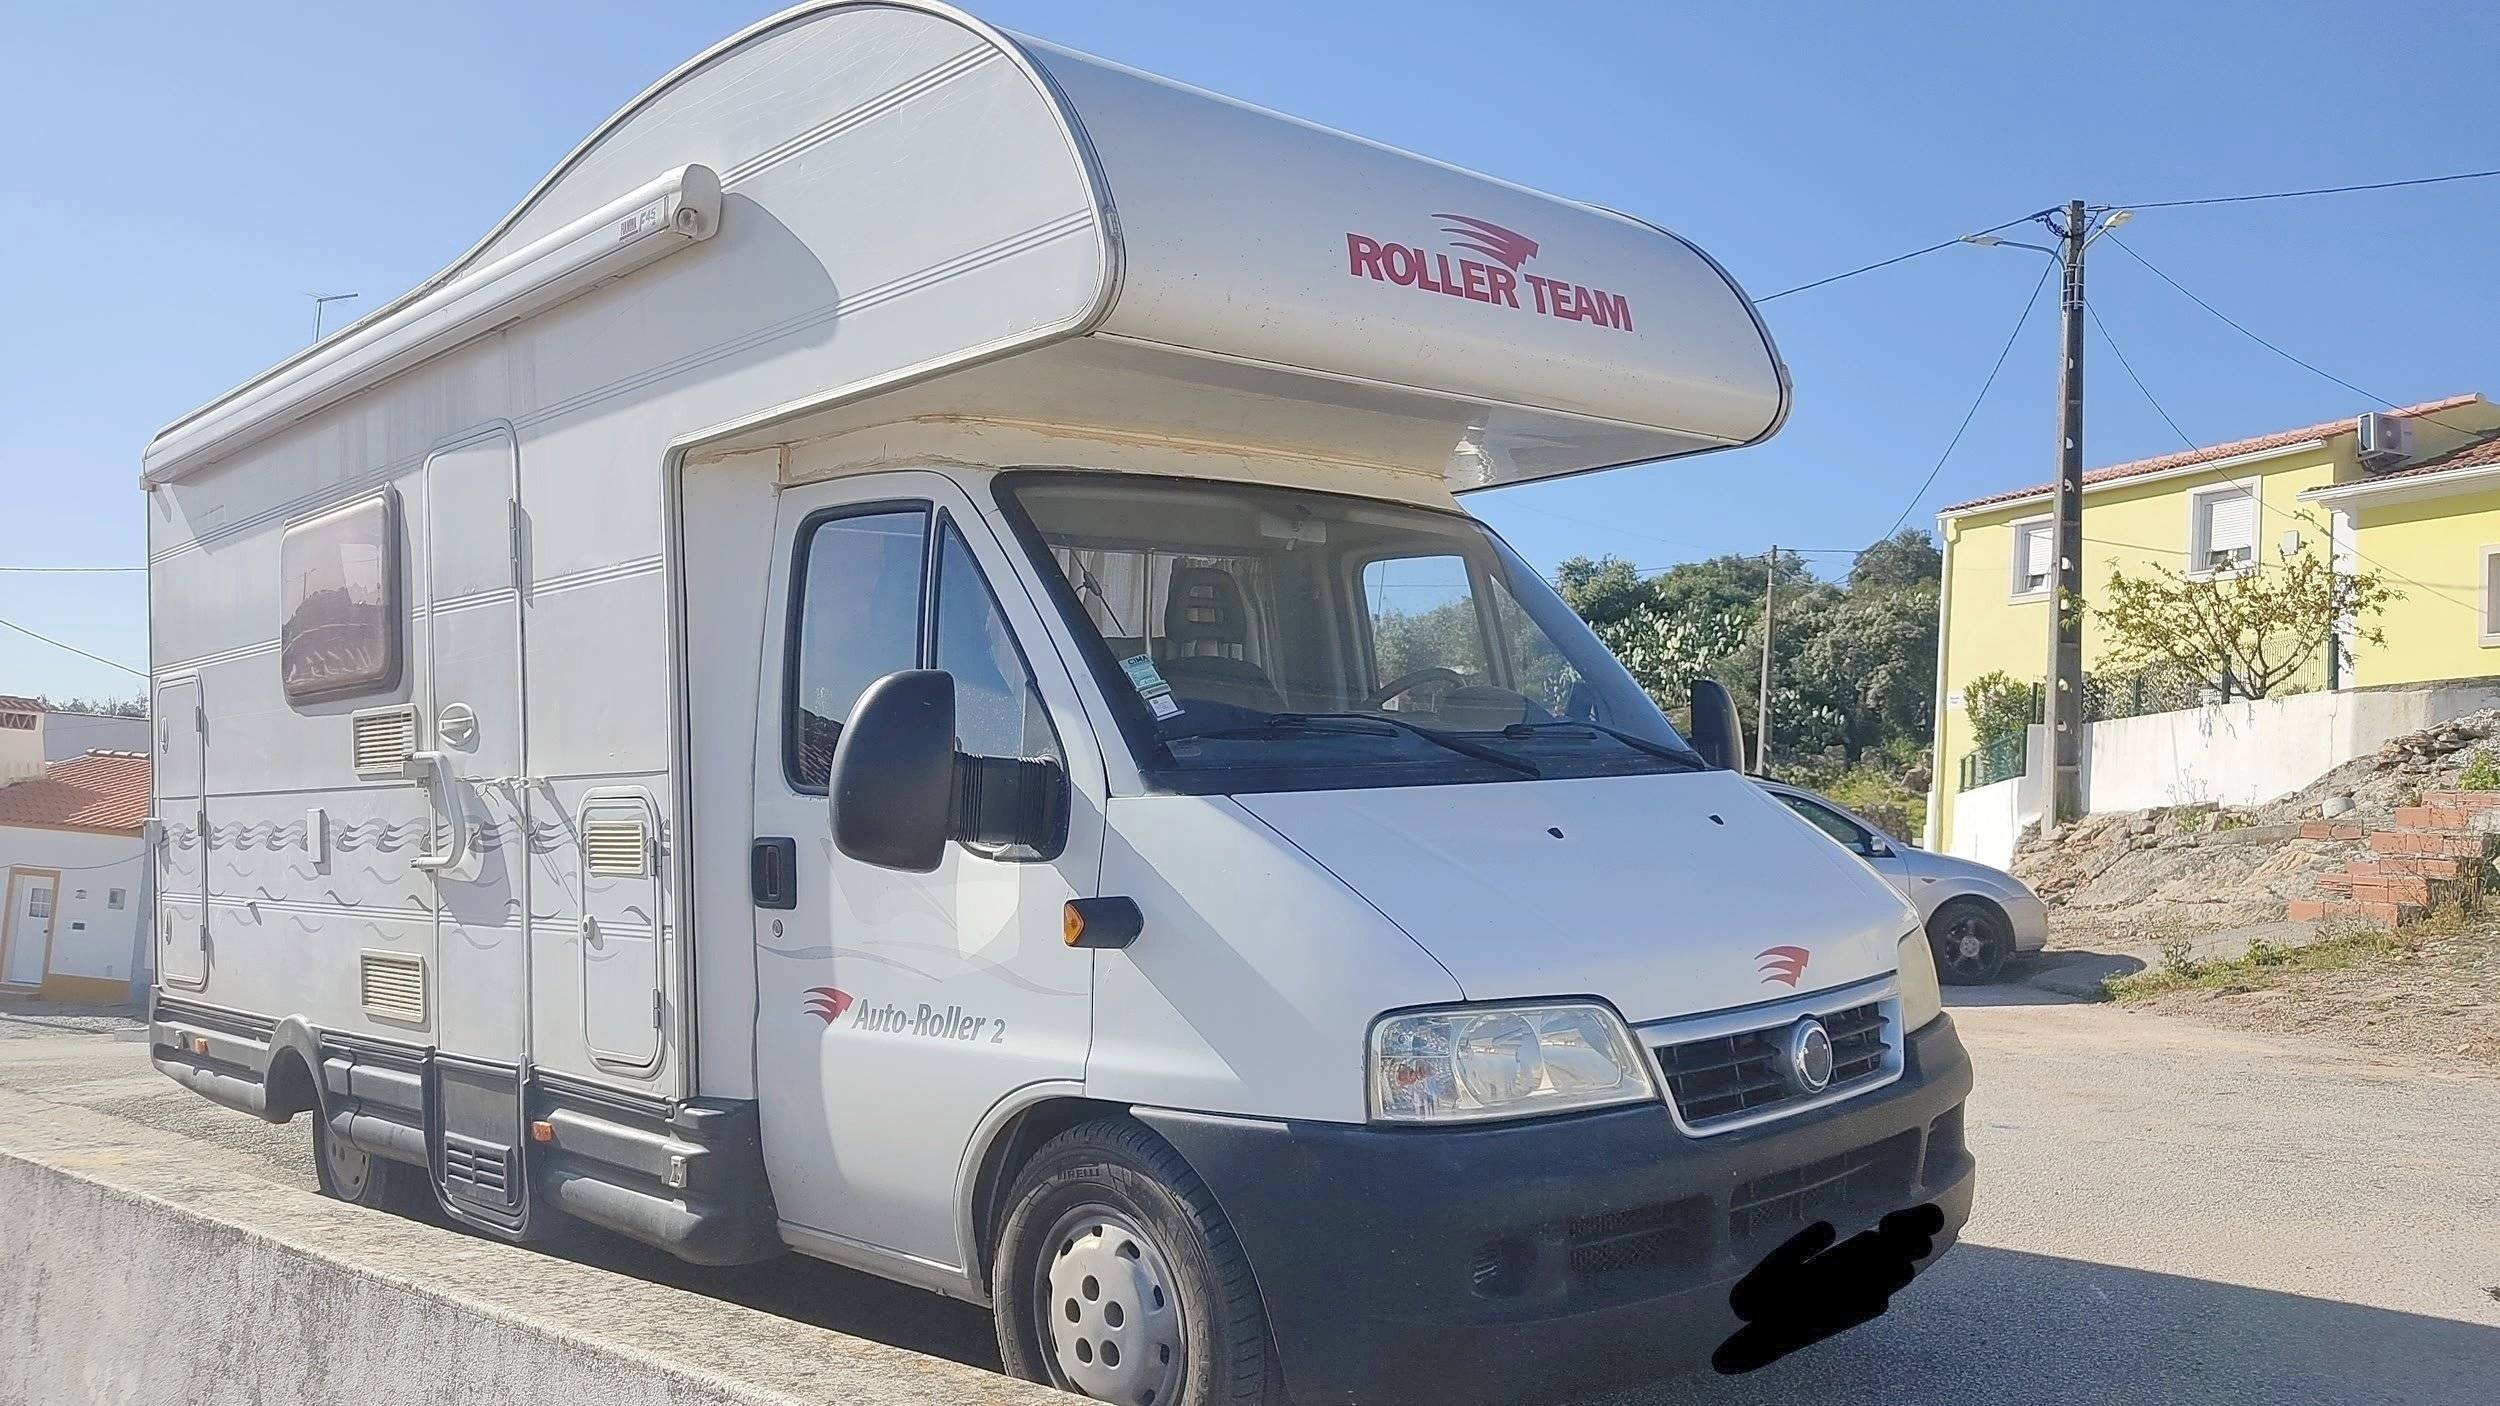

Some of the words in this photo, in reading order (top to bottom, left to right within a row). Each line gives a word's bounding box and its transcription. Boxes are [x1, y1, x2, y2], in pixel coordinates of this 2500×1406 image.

[1345, 232, 1520, 309] ROLLER
[1524, 273, 1634, 332] TEAM
[1128, 656, 1148, 664] CIMA
[851, 998, 987, 1041] Auto-Roller
[990, 1018, 1006, 1044] 2
